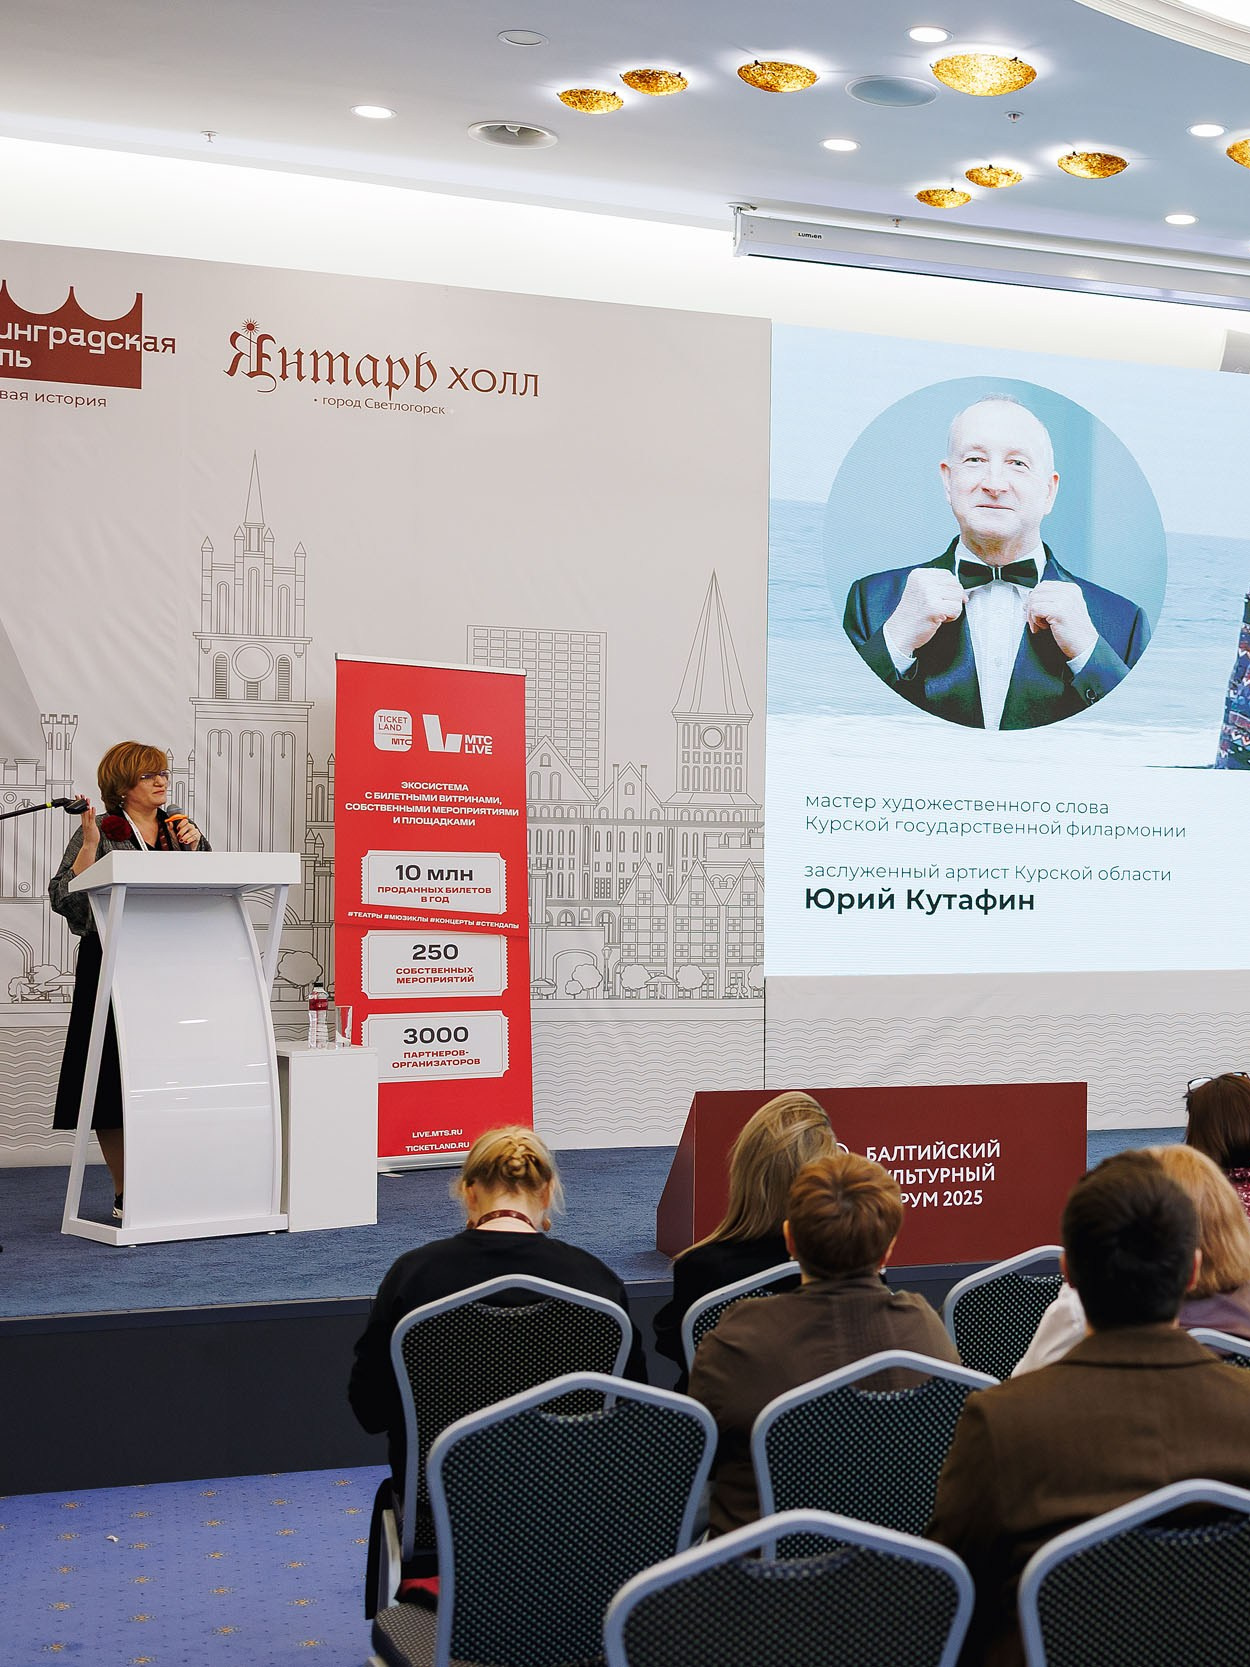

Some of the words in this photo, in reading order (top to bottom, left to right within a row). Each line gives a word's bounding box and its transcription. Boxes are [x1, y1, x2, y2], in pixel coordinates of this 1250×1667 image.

[223, 318, 438, 400] Янтарь
[35, 393, 107, 408] история
[322, 397, 361, 409] город
[364, 398, 446, 415] Светлогорск
[378, 715, 408, 724] TICKET
[378, 723, 402, 732] LAND
[464, 734, 493, 745] МТС
[464, 744, 493, 755] LIVE
[401, 782, 469, 792] ЭКОСИСТЕМА
[365, 791, 373, 800] С
[374, 792, 438, 802] БИЛЕТНЫМИ
[439, 795, 502, 806] ВИТРИНАМИ,
[805, 794, 876, 813] мастер
[881, 796, 1051, 814] художественного
[1055, 800, 1109, 815] слова
[345, 802, 431, 813] СОБСТВЕННЫМИ
[432, 806, 519, 817] МЕРОПРИЯТИЯМИ
[393, 817, 401, 825] И
[402, 817, 476, 827] ПЛОЩАДКАМИ
[805, 815, 890, 834] Курской
[894, 819, 1062, 837] государственной
[1066, 820, 1187, 838] филармонии
[395, 864, 421, 881] 10
[804, 862, 940, 880] заслуженный
[945, 867, 1010, 882] артист
[1014, 864, 1093, 882] Курской
[1098, 865, 1172, 882] области
[377, 886, 445, 894] ПРОДАННЫХ
[446, 887, 492, 895] БИЛЕТОВ
[430, 896, 450, 904] ГОД
[805, 887, 896, 915] Юрий
[906, 889, 1035, 915] Кутафин
[347, 911, 382, 919] #ТЕАТРЫ
[384, 914, 429, 923] #МЮЗИКЛЫ
[430, 917, 475, 926] #КОНЦЕРТЫ
[475, 921, 520, 930] #СТЕНДАПЫ
[412, 943, 459, 961] 250
[395, 967, 474, 975] СОБСТВЕННЫХ
[396, 975, 475, 984] МЕРОПРИЯТИЙ
[403, 1026, 469, 1045] 3000
[403, 1050, 469, 1059] ПАРТНЕРОВ-
[391, 1058, 481, 1069] ОРГАНИЗАТОРОВ
[412, 1129, 463, 1139] LIVE.MTS.RU
[405, 1141, 470, 1152] TICKETLAND.RU
[866, 1139, 1001, 1163] БАЛТИЙСКИЙ
[889, 1163, 995, 1185] ЛЬТУРНЫЙ
[901, 1192, 938, 1208] РУМ
[943, 1189, 983, 1207] 2025
